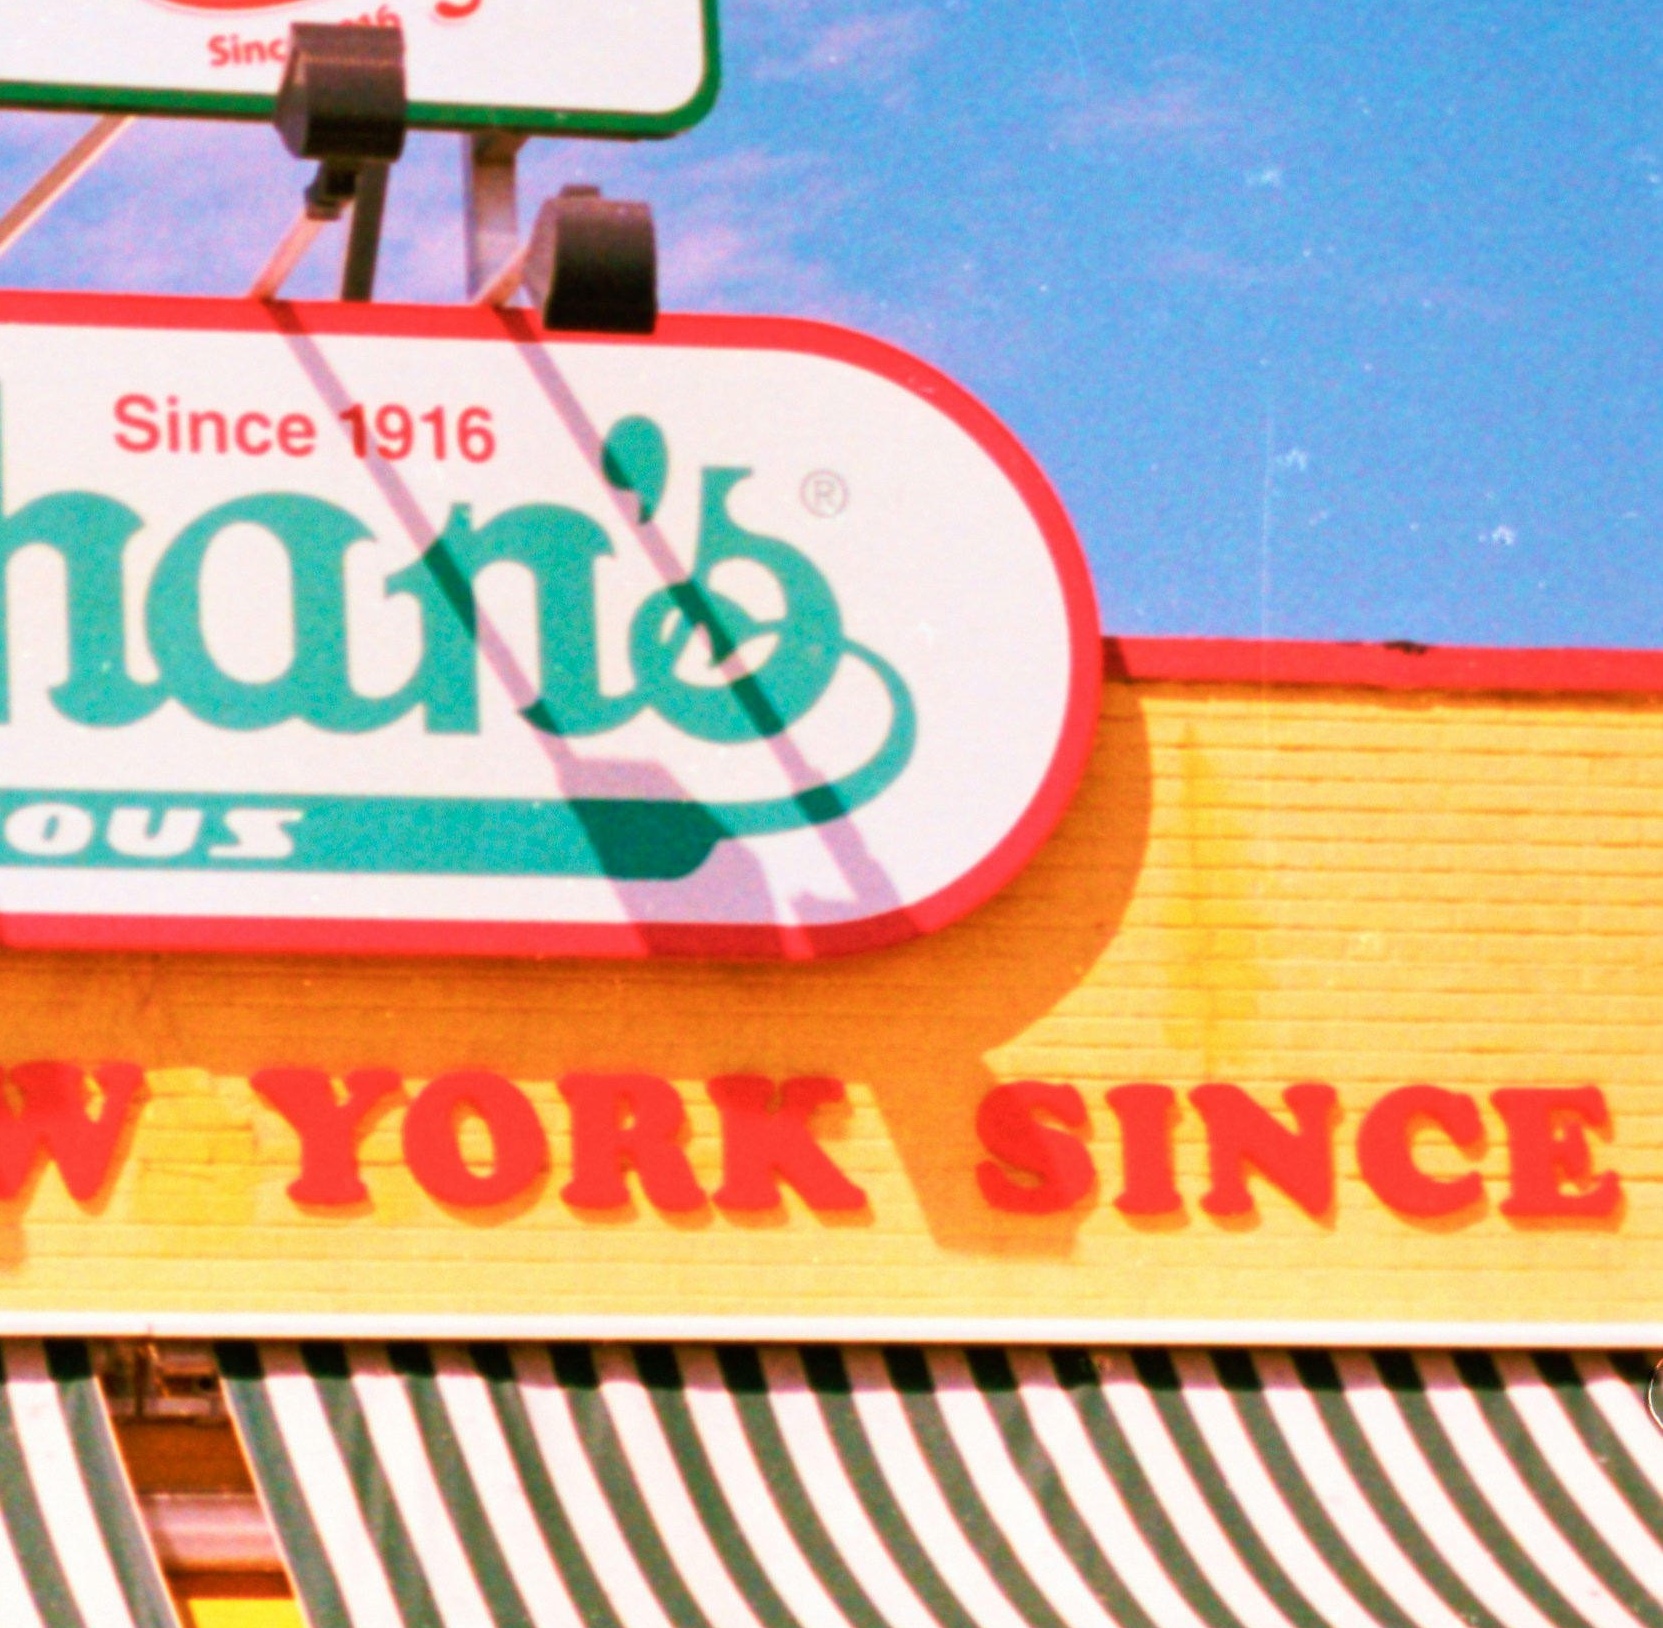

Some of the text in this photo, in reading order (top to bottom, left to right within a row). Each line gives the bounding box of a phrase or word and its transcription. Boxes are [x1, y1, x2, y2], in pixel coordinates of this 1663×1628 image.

[206, 32, 287, 68] Sinc
[112, 391, 499, 465] Since 1916
[249, 1066, 869, 1216] YORK
[973, 1078, 1622, 1223] SINCE
